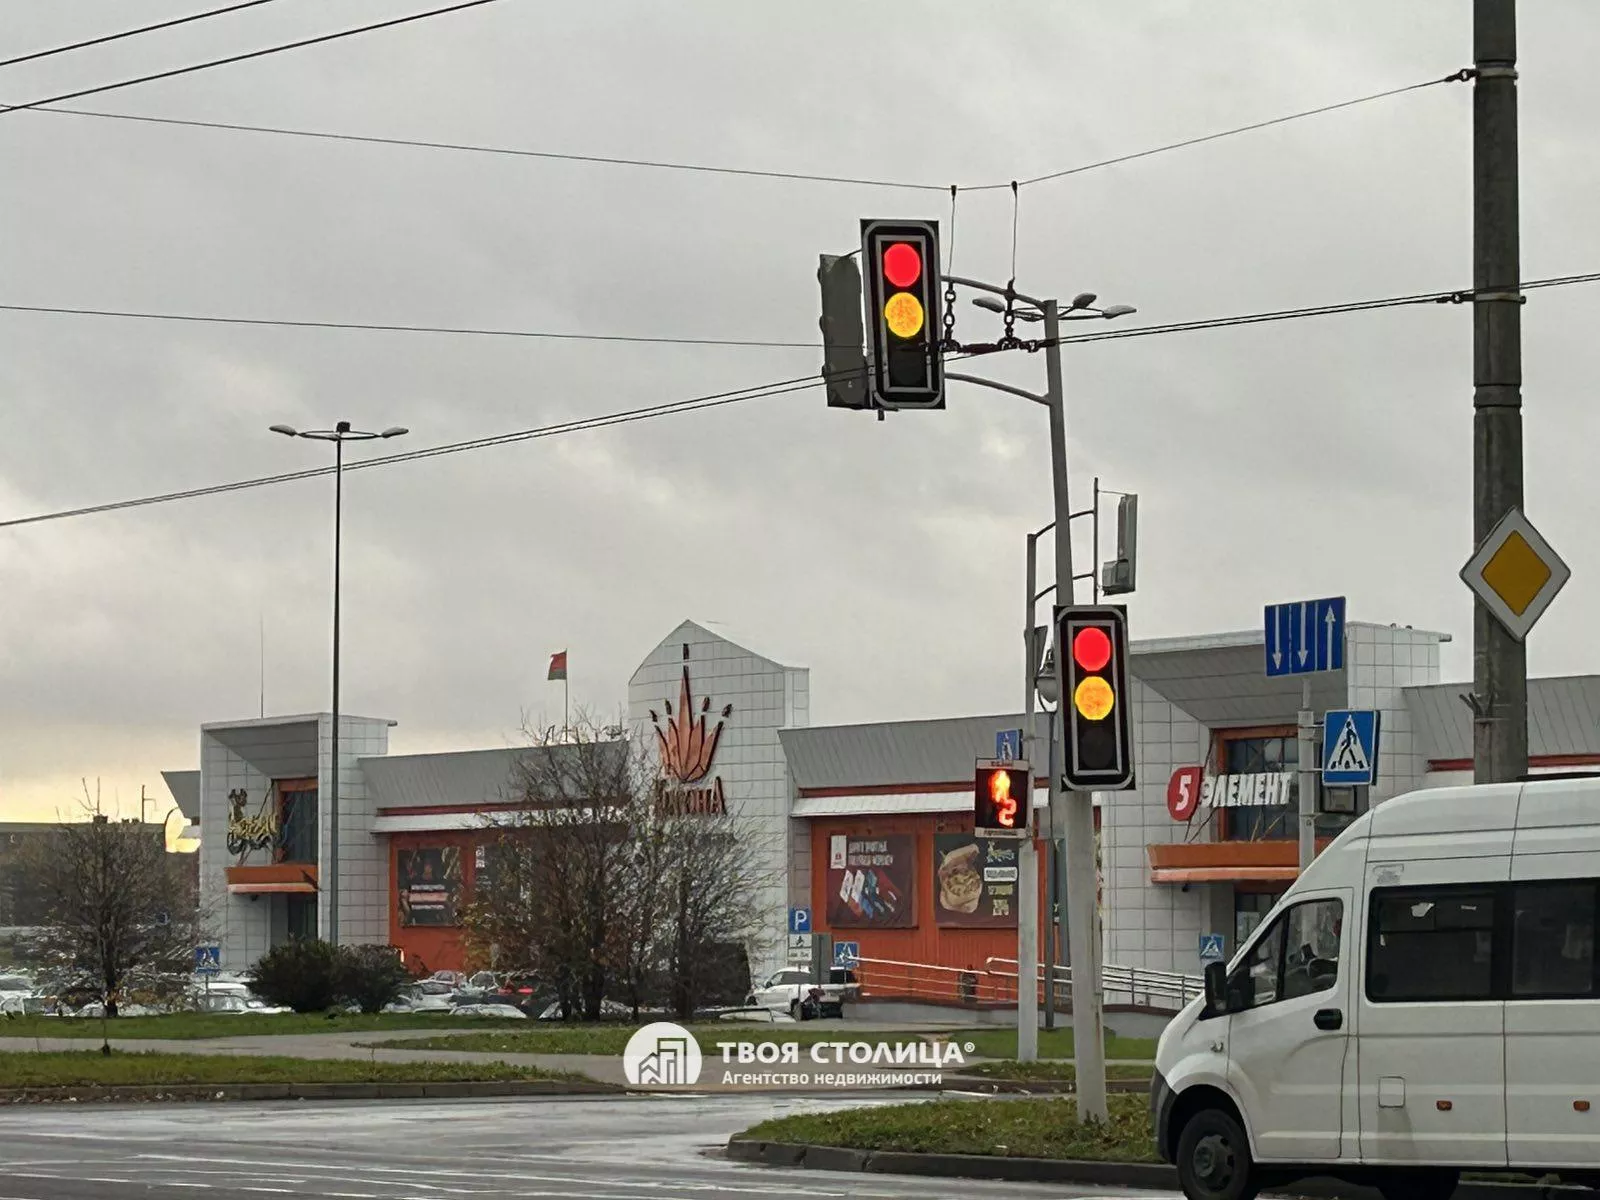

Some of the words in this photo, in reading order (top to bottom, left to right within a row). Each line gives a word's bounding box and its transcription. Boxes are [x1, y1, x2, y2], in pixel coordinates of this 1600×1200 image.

[1175, 775, 1192, 811] 5
[1200, 771, 1292, 808] ЭЛЕМЕНТ
[794, 910, 807, 931] P
